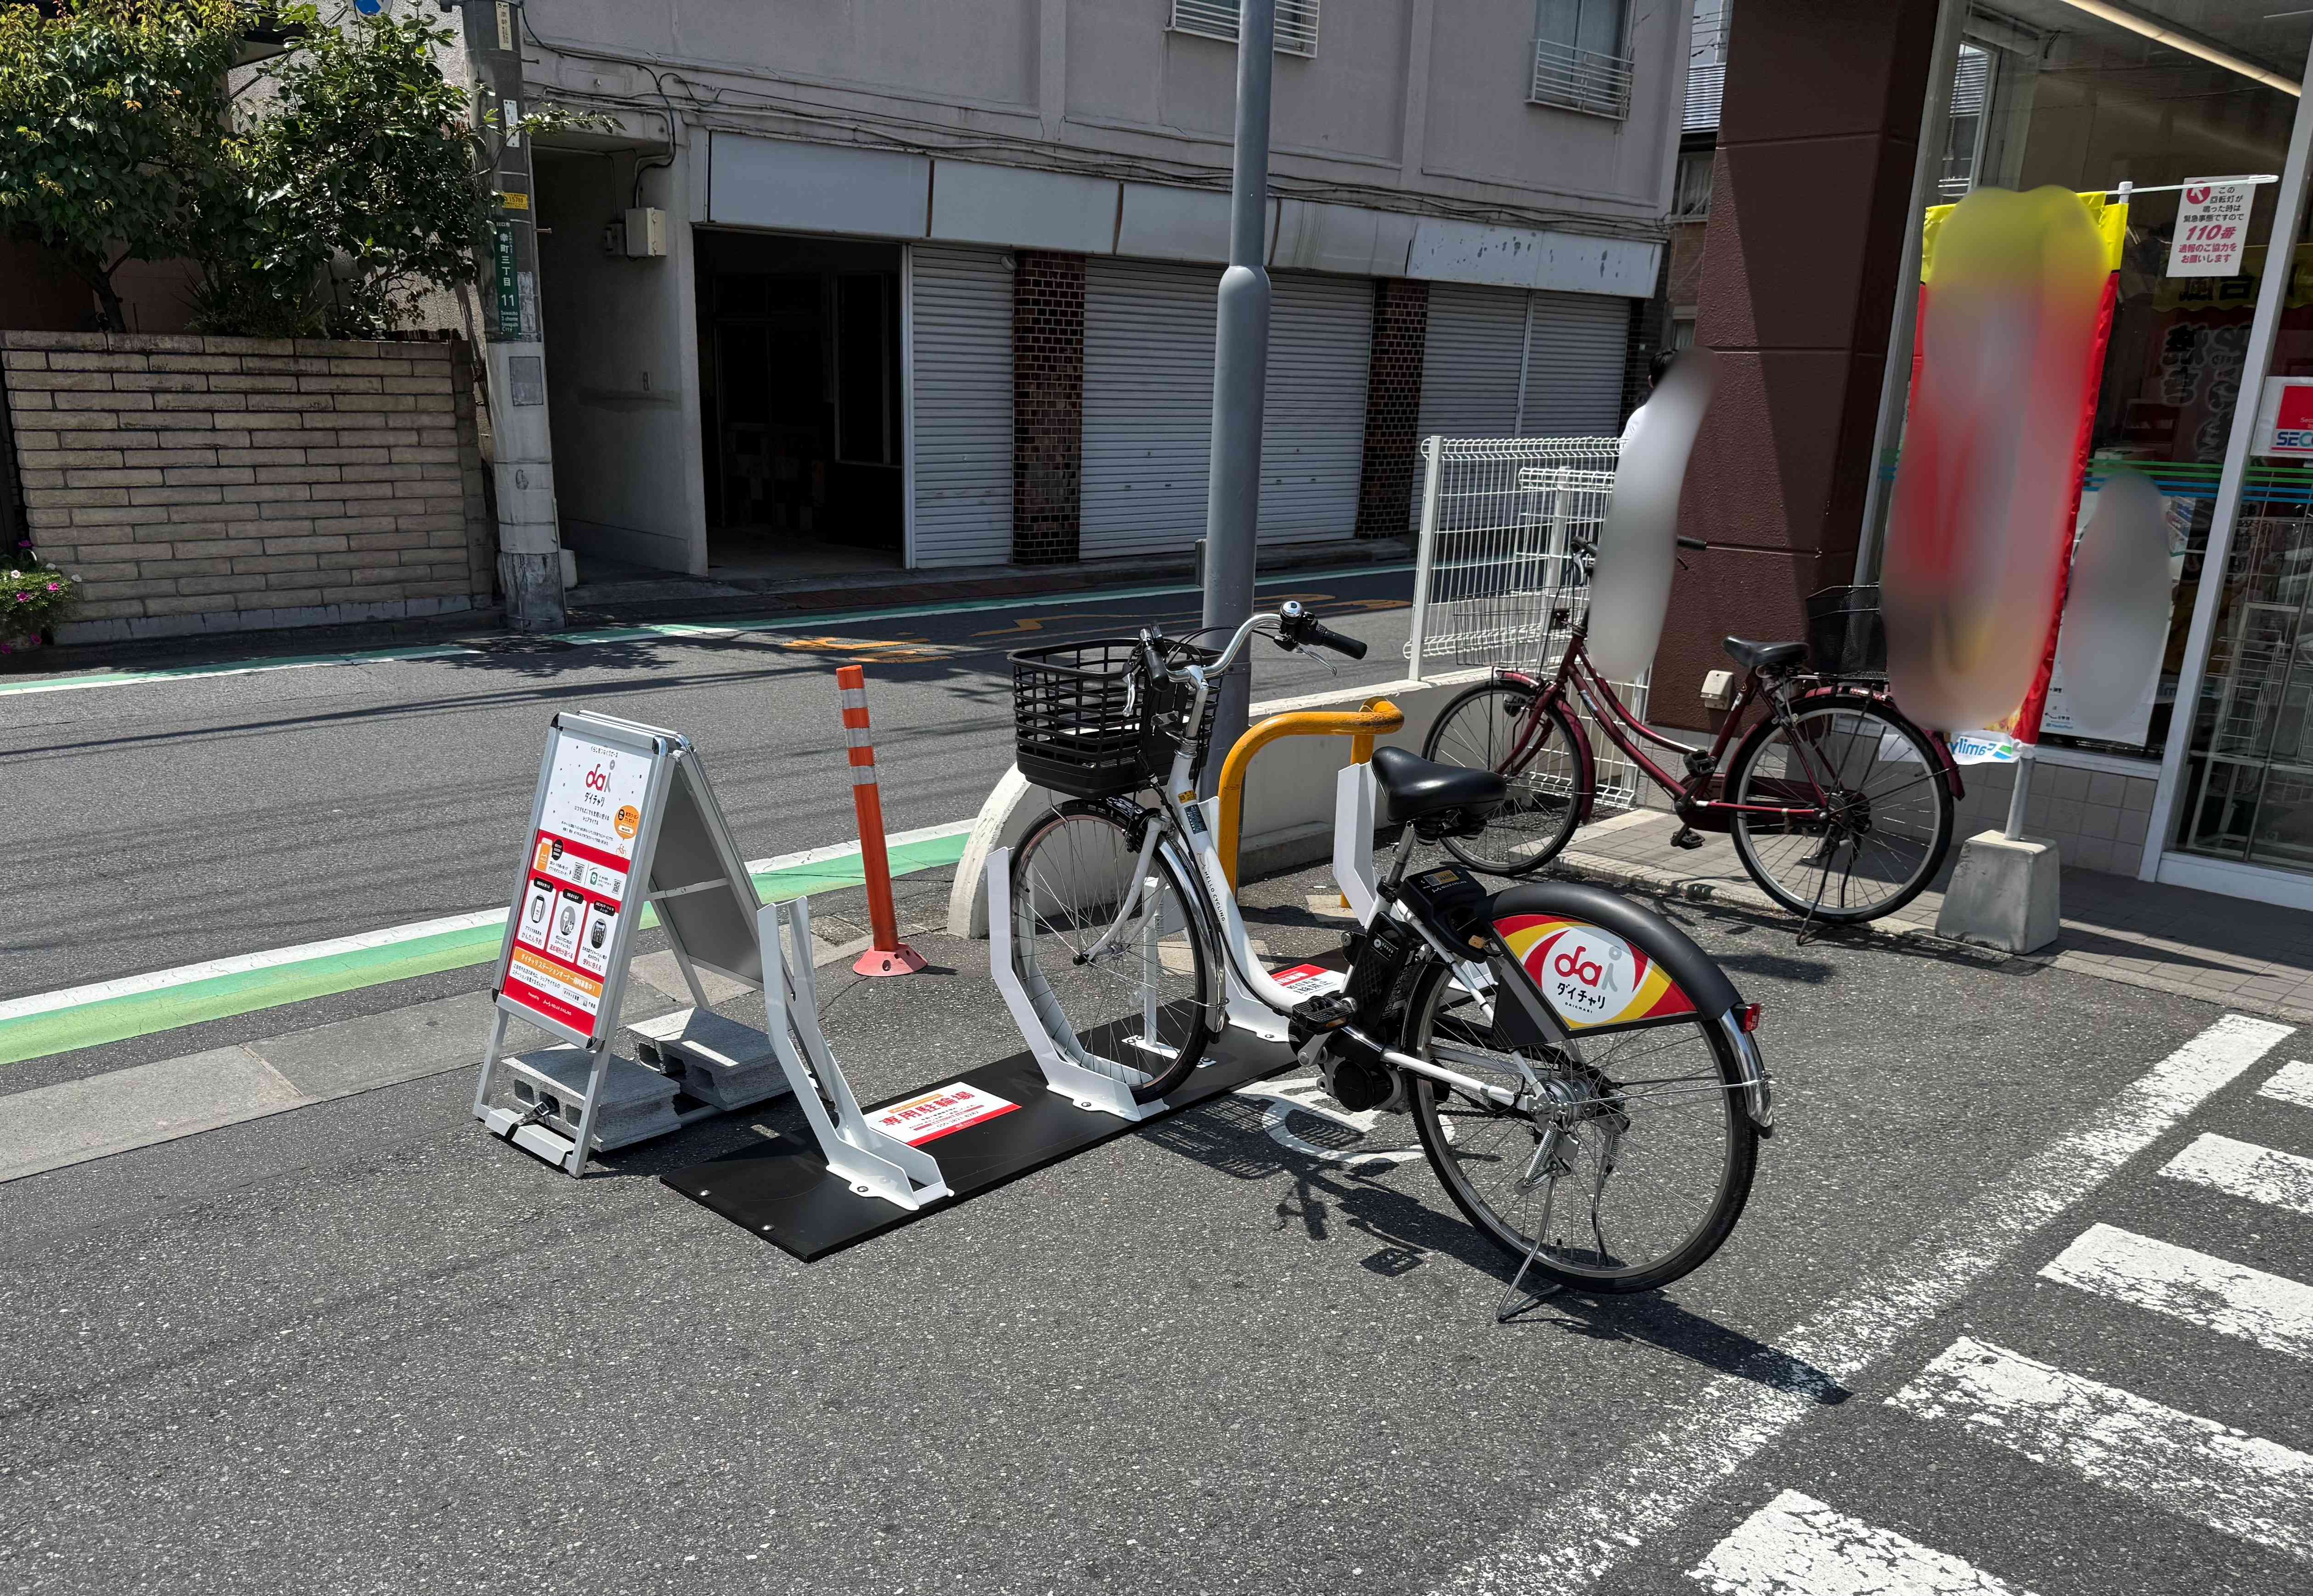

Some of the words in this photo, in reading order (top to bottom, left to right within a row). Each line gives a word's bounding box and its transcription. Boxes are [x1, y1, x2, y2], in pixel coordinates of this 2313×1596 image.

[2210, 195, 2244, 204] 回転灯が
[2183, 214, 2245, 223] 緊急事態ですので
[2185, 224, 2238, 241] 110番
[2178, 242, 2238, 253] 通報のご協力を
[499, 233, 511, 287] 幸町三丁目
[2181, 254, 2232, 264] お願いします
[501, 294, 514, 306] 11
[2276, 432, 2313, 447] SEC
[585, 792, 605, 807] ダイチャリ
[1204, 871, 1215, 892] HELLO
[1554, 946, 1622, 992] dai
[1557, 982, 1605, 1009] ダイチャリ
[1565, 1002, 1593, 1014] DAICHARI
[878, 1091, 975, 1125] 専用駐輪場
